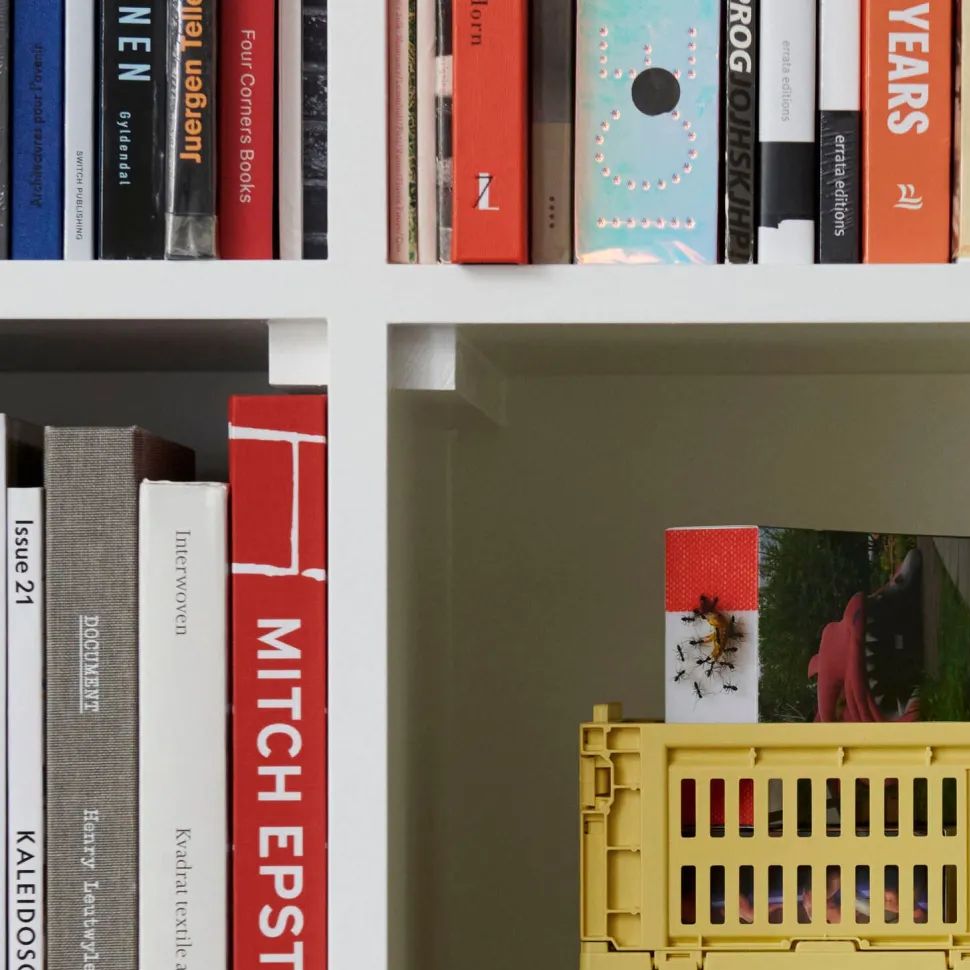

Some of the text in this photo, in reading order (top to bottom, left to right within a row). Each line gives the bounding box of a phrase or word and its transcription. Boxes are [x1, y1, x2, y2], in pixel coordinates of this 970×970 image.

[180, 60, 207, 163] Juergen
[240, 29, 255, 203] Four Corners Books
[782, 40, 792, 122] errata editions
[887, 3, 930, 134] YEARS
[117, 111, 132, 185] Gyldendal
[835, 135, 849, 236] errata editions
[15, 520, 34, 605] Issue 21
[175, 530, 191, 636] Interwoven
[79, 615, 99, 712] DOCUMENT
[256, 619, 303, 802] MITCH
[82, 810, 99, 868] Henry
[175, 828, 191, 897] Kvadrat
[175, 901, 191, 957] textile
